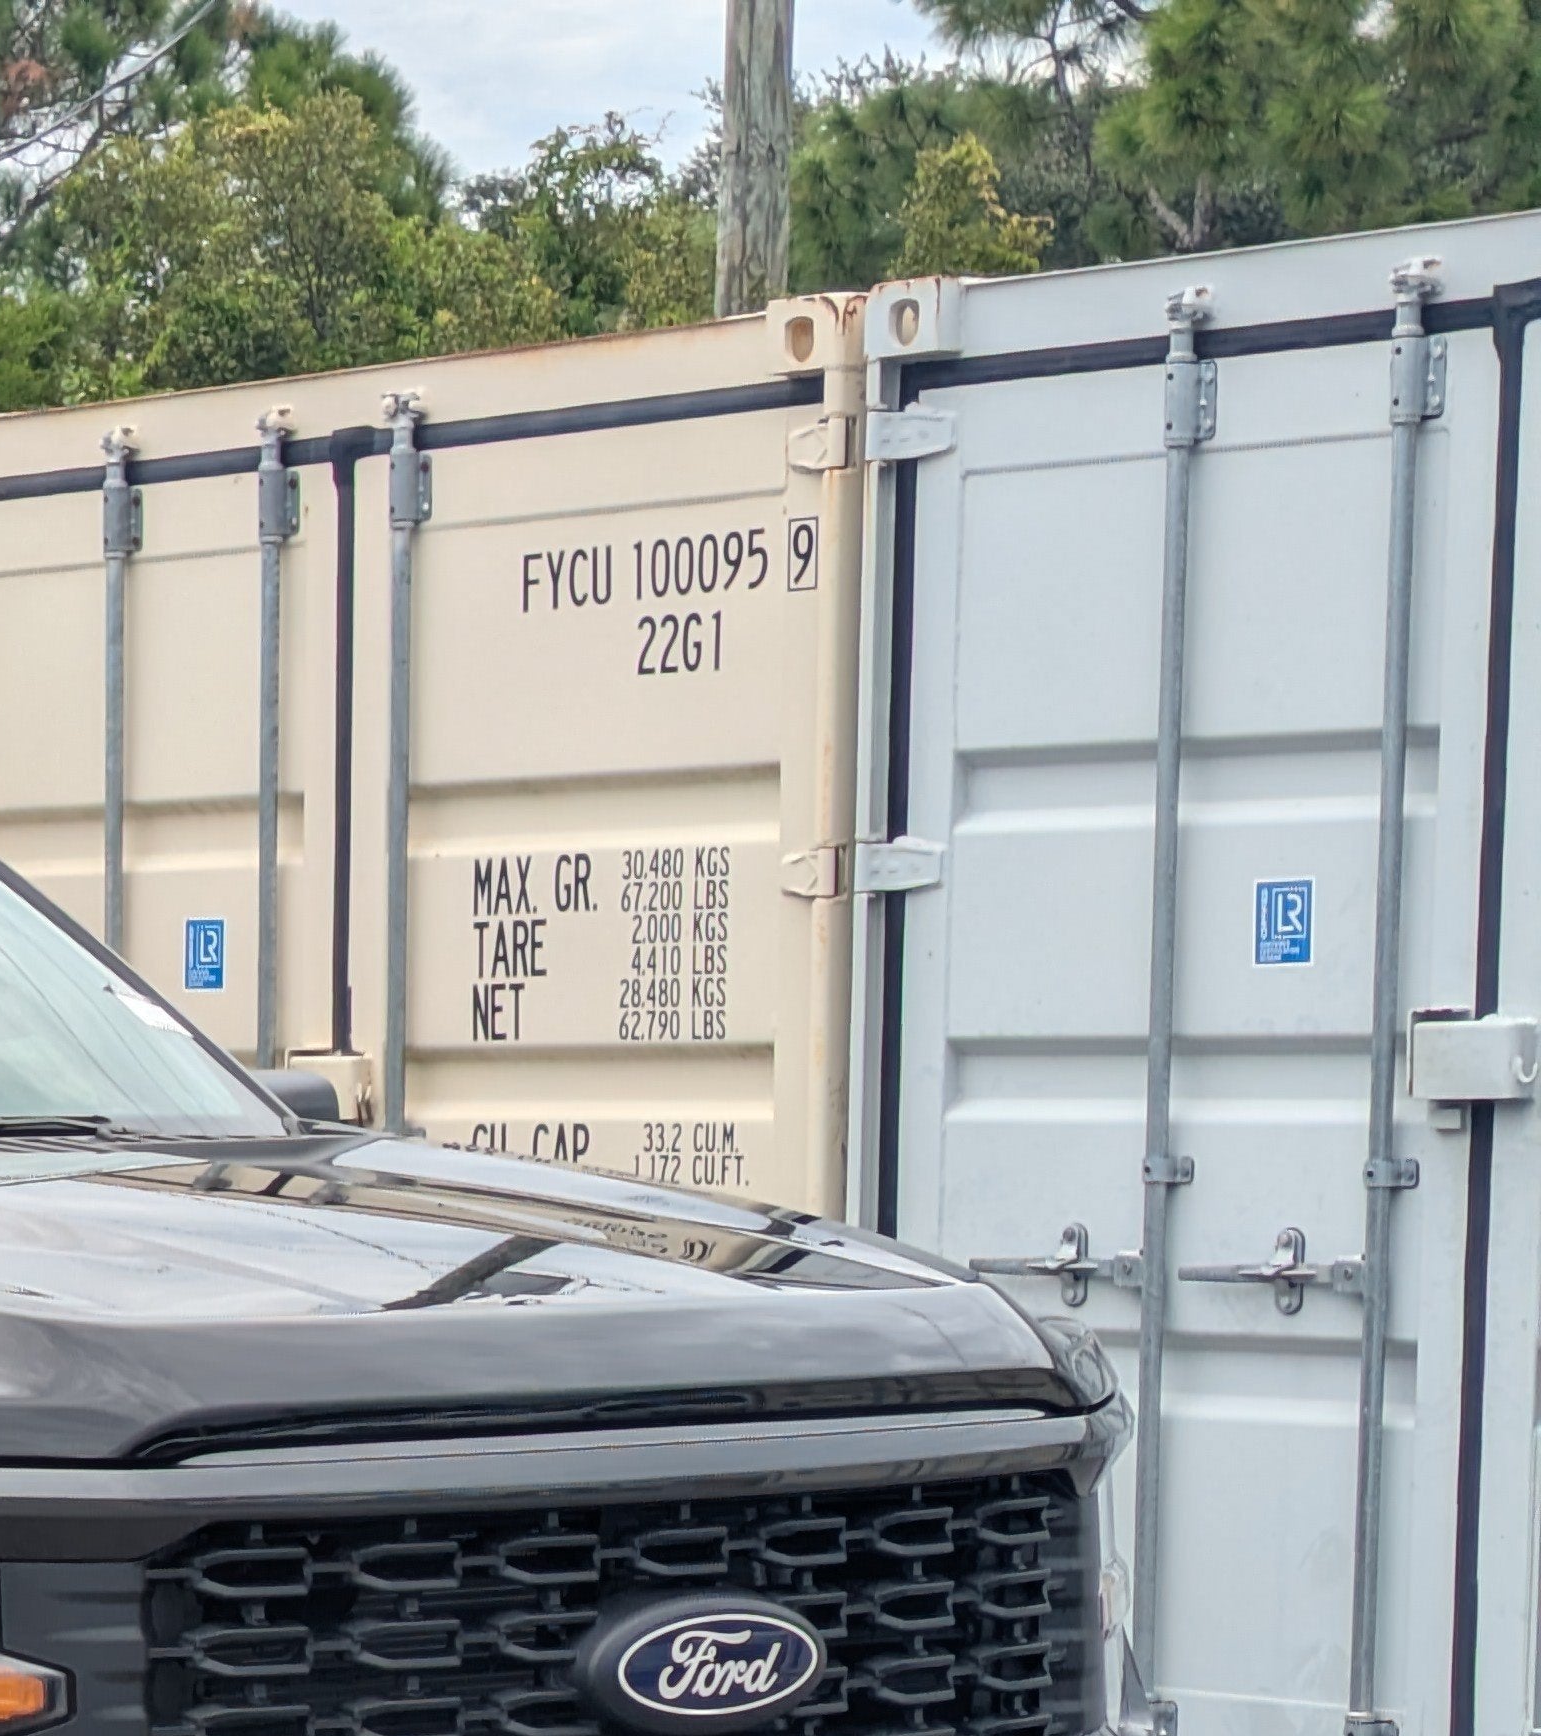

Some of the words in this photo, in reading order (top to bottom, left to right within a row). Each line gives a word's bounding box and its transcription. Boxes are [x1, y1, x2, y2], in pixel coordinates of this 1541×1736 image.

[522, 545, 612, 613] FYCU
[633, 527, 768, 601] 100095
[789, 523, 815, 585] 9
[637, 610, 722, 675] 22G1
[473, 855, 538, 916] MAX.
[554, 852, 598, 913] GR.
[694, 846, 730, 877] KGS
[693, 879, 729, 910] LBS
[1278, 893, 1302, 932] LR
[200, 930, 218, 963] LR
[473, 918, 547, 978] TARE
[692, 912, 729, 942] KGS
[692, 944, 727, 975] LBS
[472, 983, 525, 1041] NET
[691, 977, 727, 1008] KGS
[691, 1009, 726, 1040] LBS
[643, 1122, 682, 1153] 33.2
[693, 1122, 739, 1154] CU.M.
[634, 1154, 681, 1184] 1172
[692, 1155, 750, 1187] CU.FT.
[658, 1629, 782, 1700] Ford
